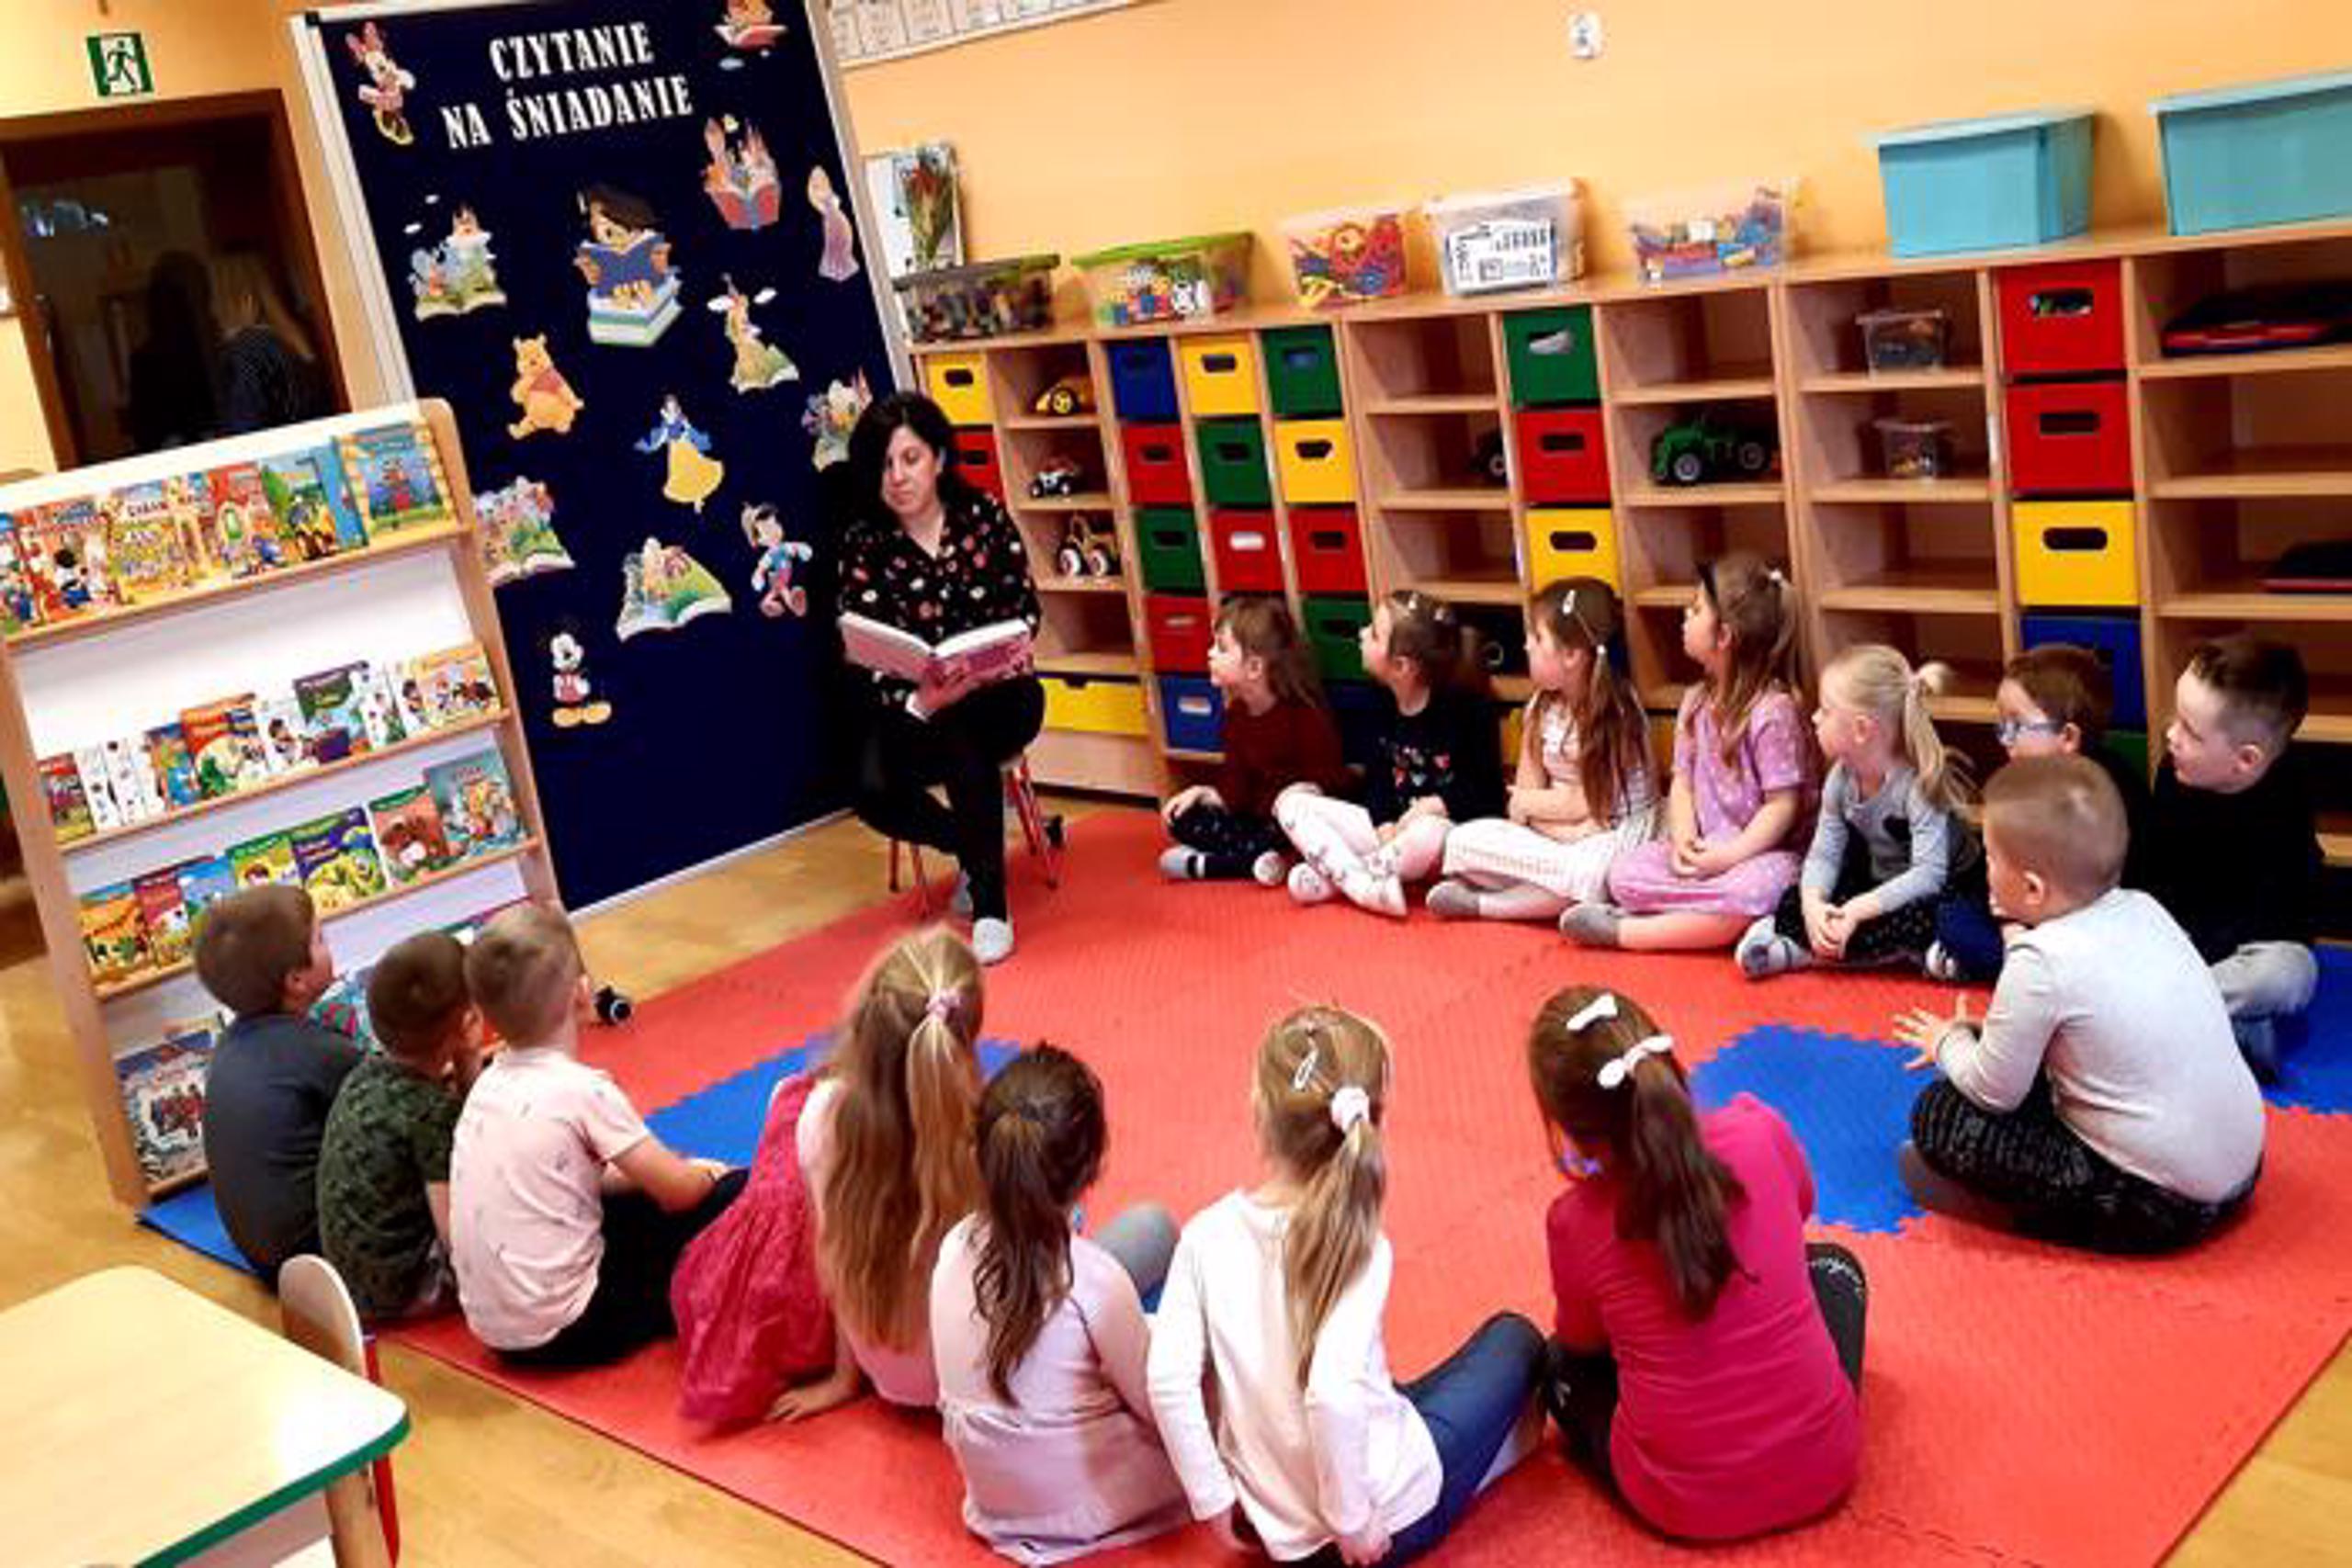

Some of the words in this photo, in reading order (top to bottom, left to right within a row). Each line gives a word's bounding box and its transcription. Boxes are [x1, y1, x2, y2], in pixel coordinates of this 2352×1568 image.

[489, 23, 654, 82] CZYTANIE
[441, 104, 492, 148] NA
[505, 75, 693, 141] ŚNIADANIE
